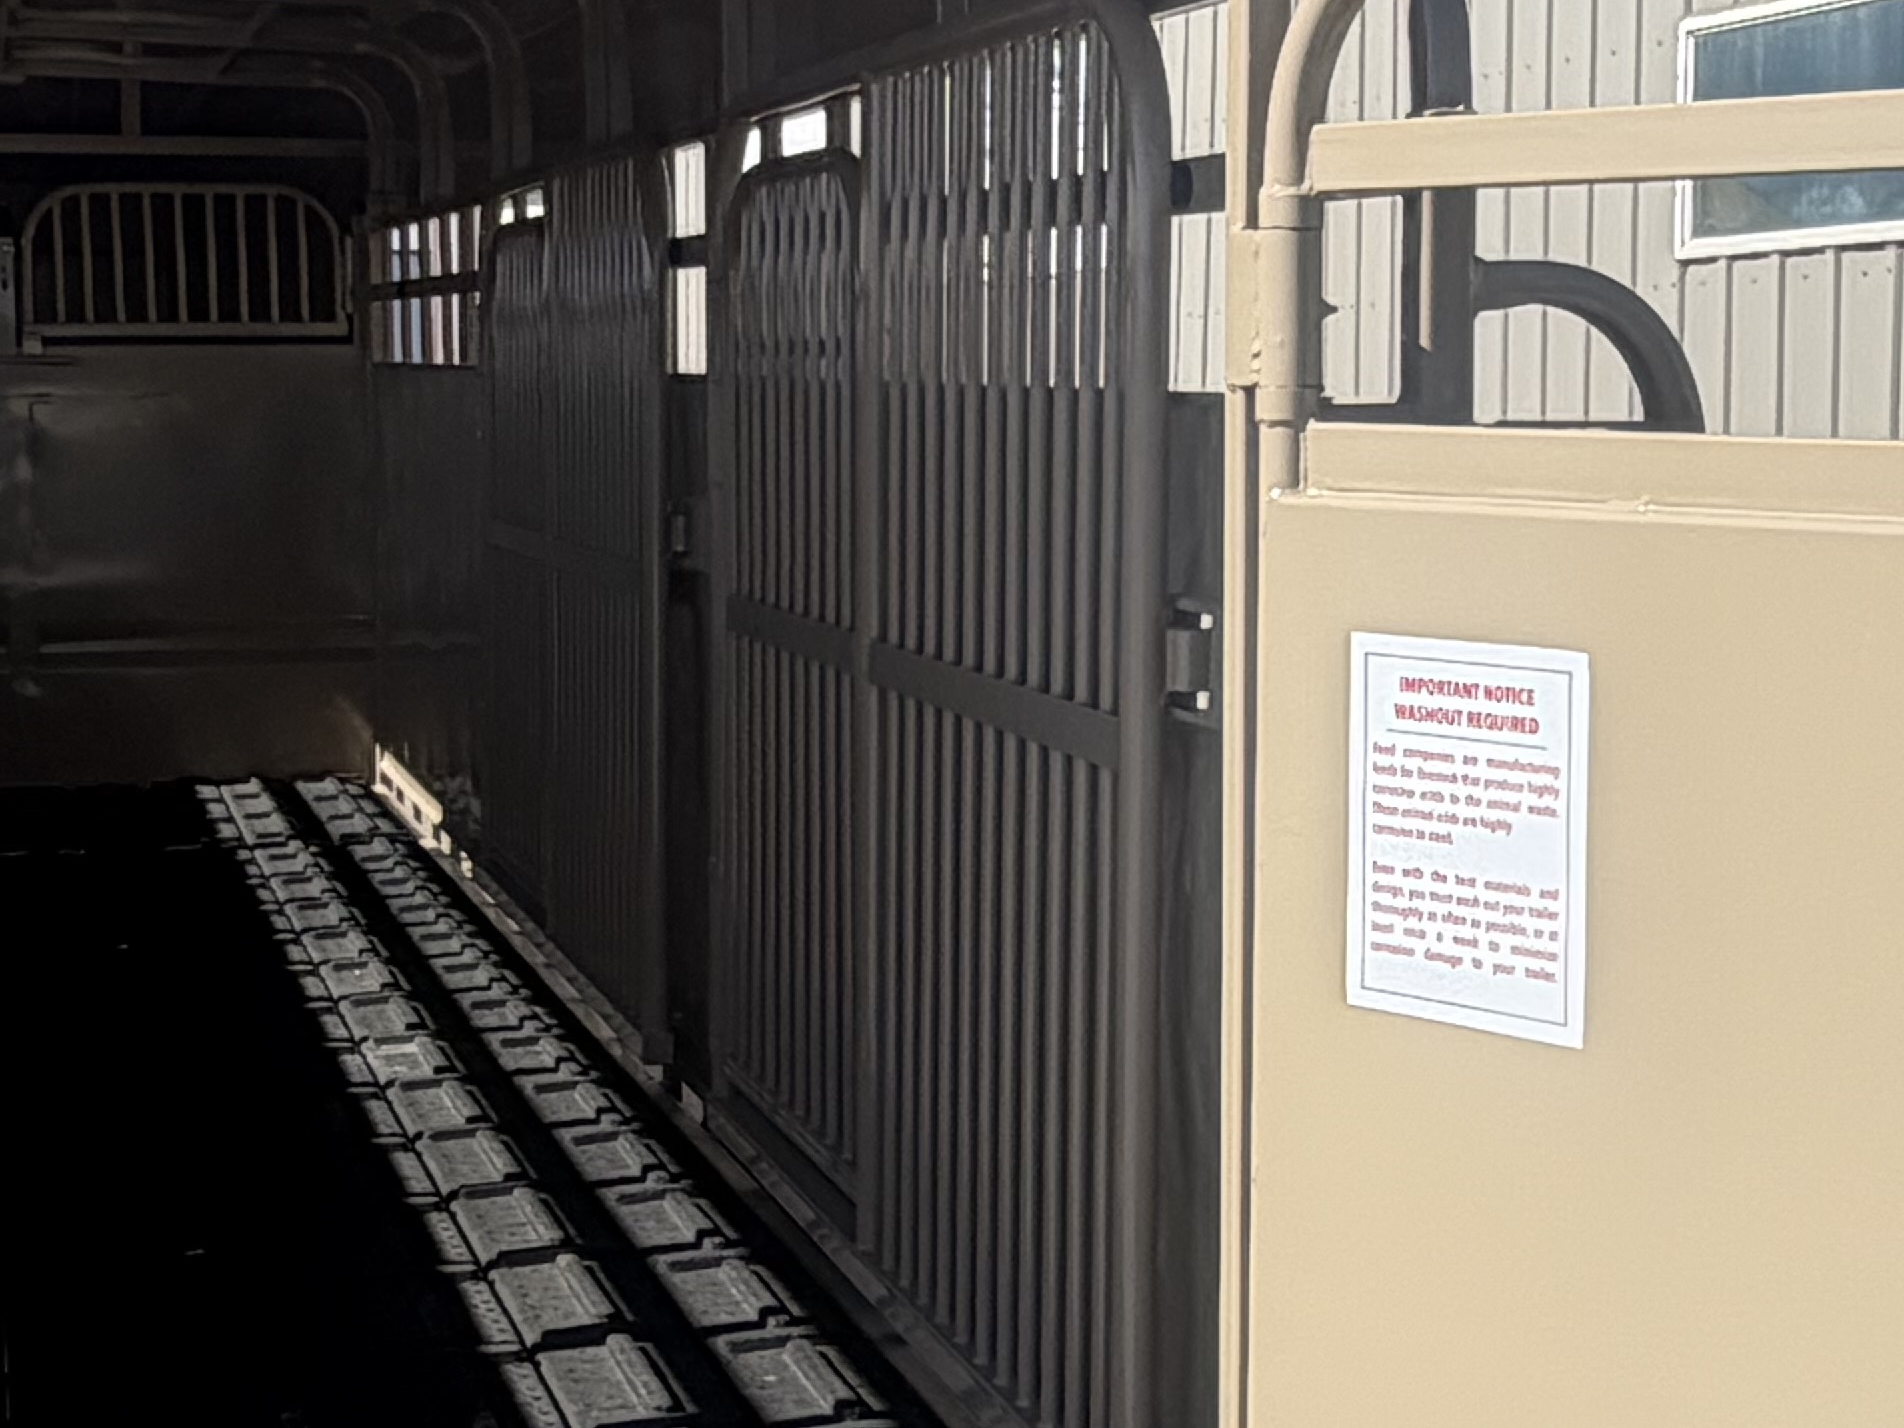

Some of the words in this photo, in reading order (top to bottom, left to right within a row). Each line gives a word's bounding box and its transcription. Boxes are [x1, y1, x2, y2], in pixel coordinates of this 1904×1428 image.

[1399, 676, 1480, 700] IMPORTANT
[1484, 684, 1535, 706] NOTICE
[1395, 703, 1463, 726] WASHOUT
[1467, 711, 1539, 735] REQUIRED
